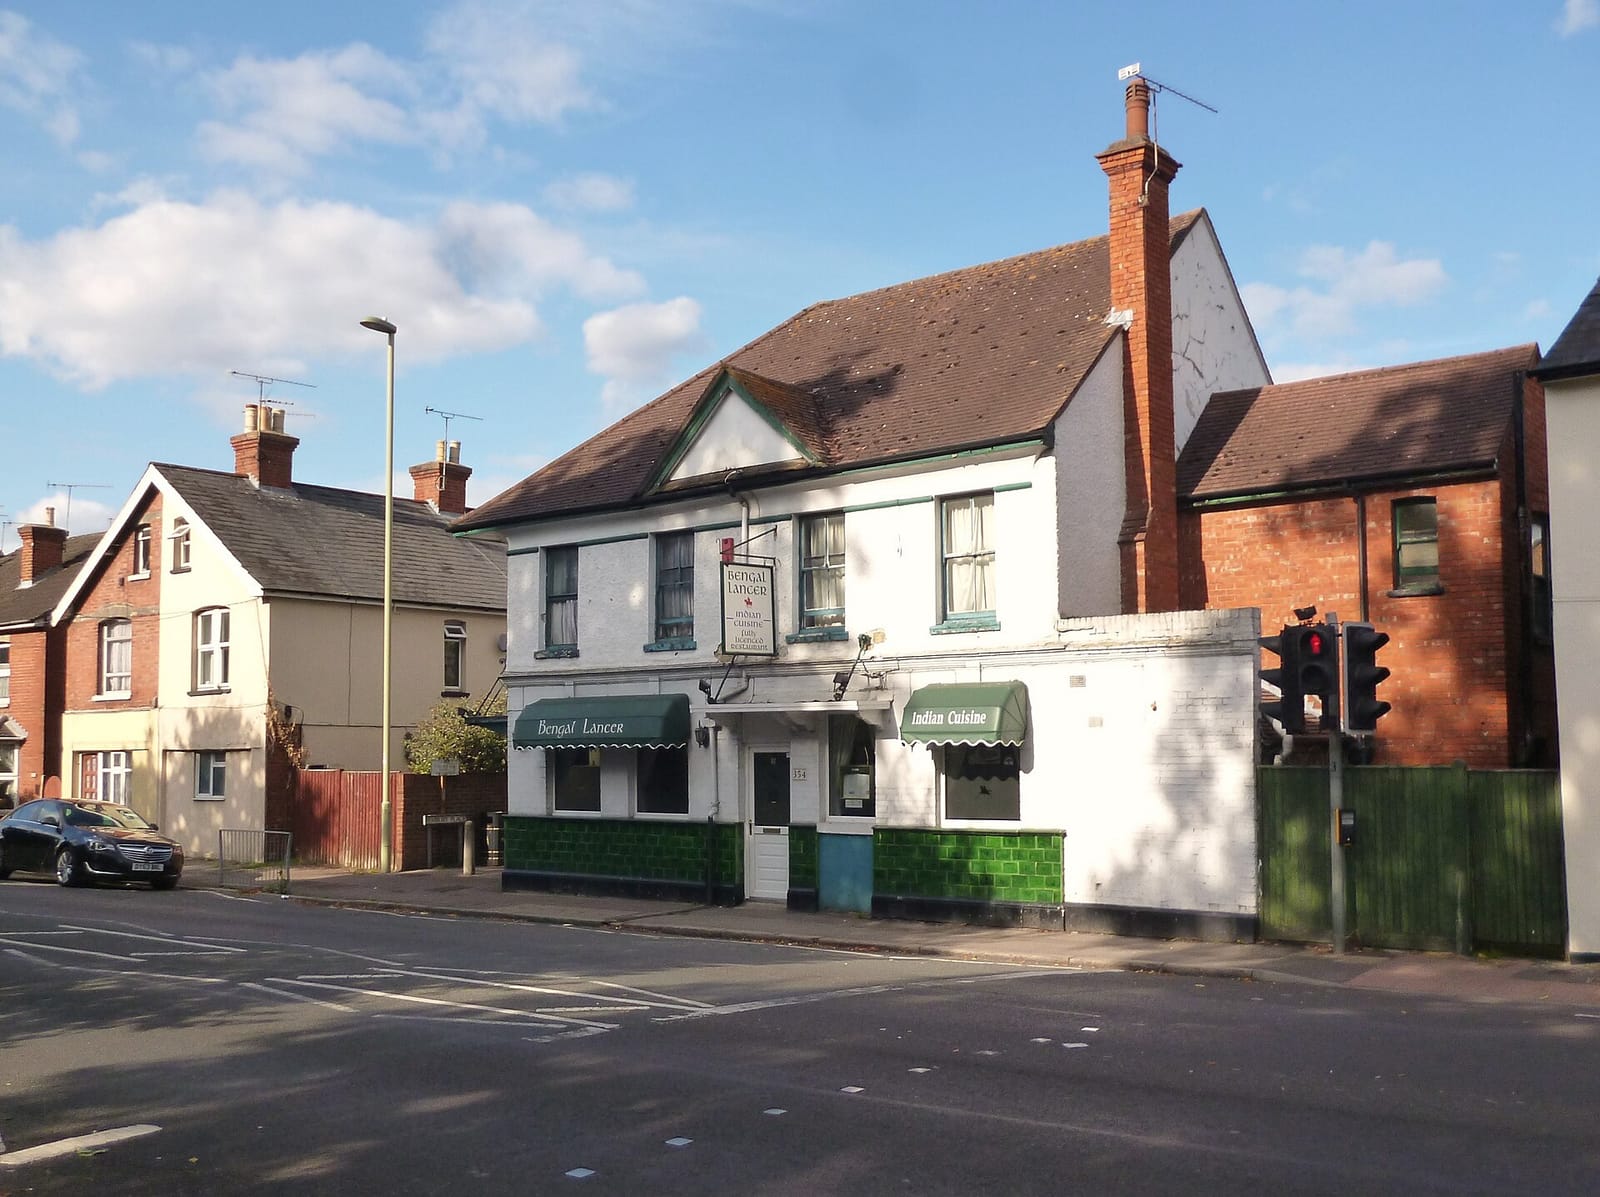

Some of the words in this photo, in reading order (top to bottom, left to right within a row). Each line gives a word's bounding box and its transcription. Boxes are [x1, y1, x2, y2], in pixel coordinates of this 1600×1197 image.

[911, 709, 944, 725] Indian
[947, 709, 987, 725] Cuisine
[538, 719, 577, 739] Bengal
[792, 769, 807, 779] 354
